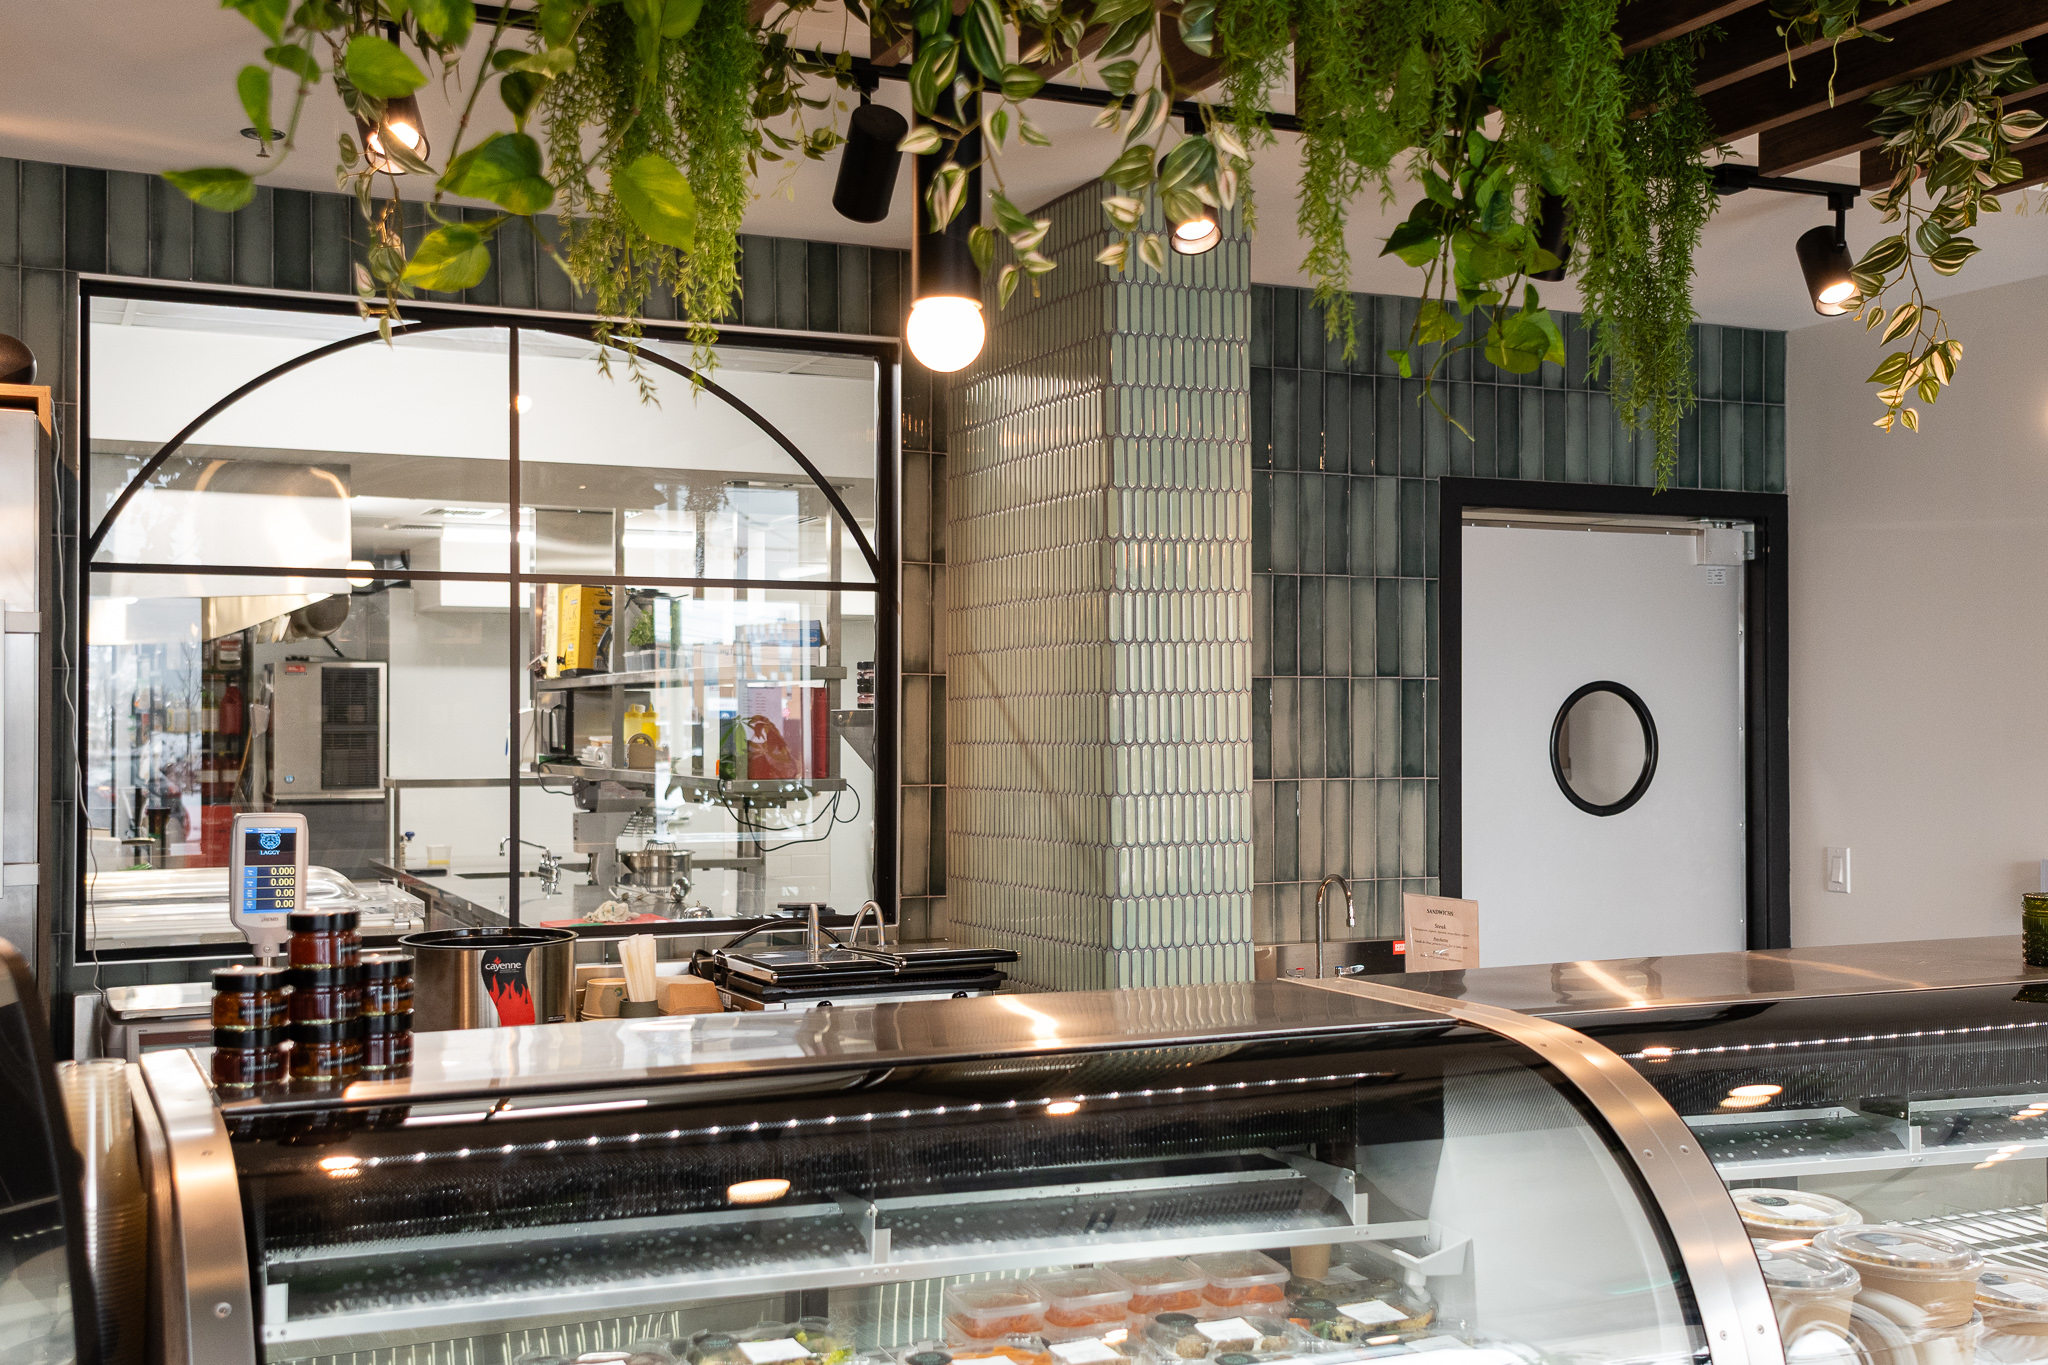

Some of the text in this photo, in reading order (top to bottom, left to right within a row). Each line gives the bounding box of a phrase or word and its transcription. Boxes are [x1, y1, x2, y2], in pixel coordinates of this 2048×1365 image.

[271, 867, 295, 875] 0.000
[270, 878, 294, 886] 0.000
[275, 889, 294, 897] 0.00
[275, 900, 294, 908] 0.00
[485, 962, 522, 972] cayenne
